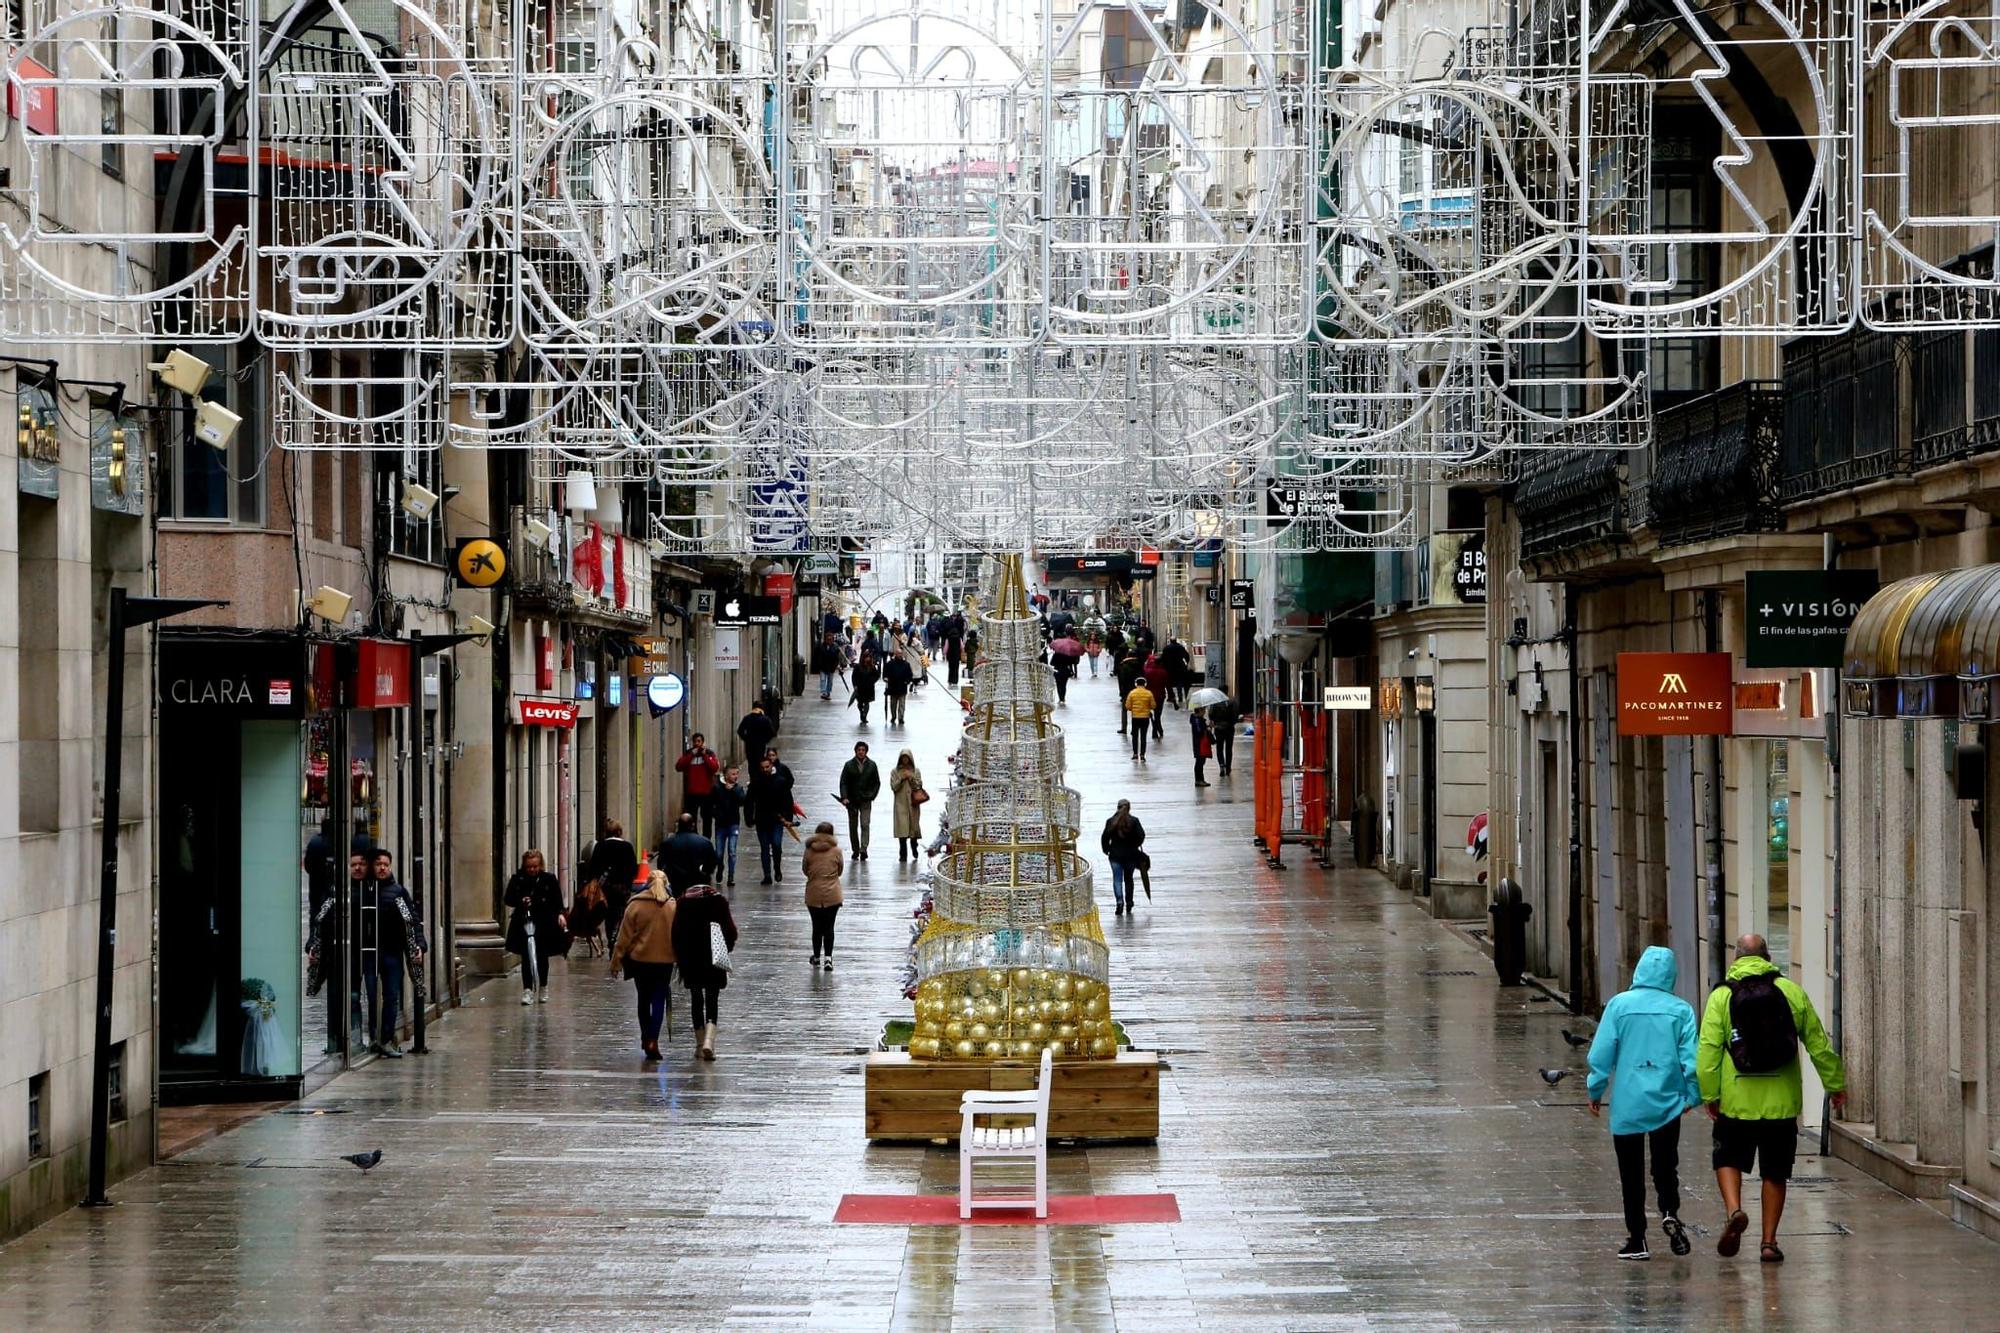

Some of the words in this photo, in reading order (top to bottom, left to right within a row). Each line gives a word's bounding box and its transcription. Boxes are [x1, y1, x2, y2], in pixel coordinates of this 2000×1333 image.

[1286, 490, 1296, 501] El
[1463, 551, 1472, 566] El
[1457, 568, 1470, 583] de
[1759, 627, 1769, 635] El
[1771, 627, 1783, 635] fin
[1784, 627, 1796, 635] de
[1797, 627, 1811, 635] las
[1812, 627, 1838, 637] gafas
[171, 674, 253, 703] CLARÁ
[1326, 693, 1368, 702] BROWNIE
[1625, 701, 1723, 710] PACOMARTINEZ
